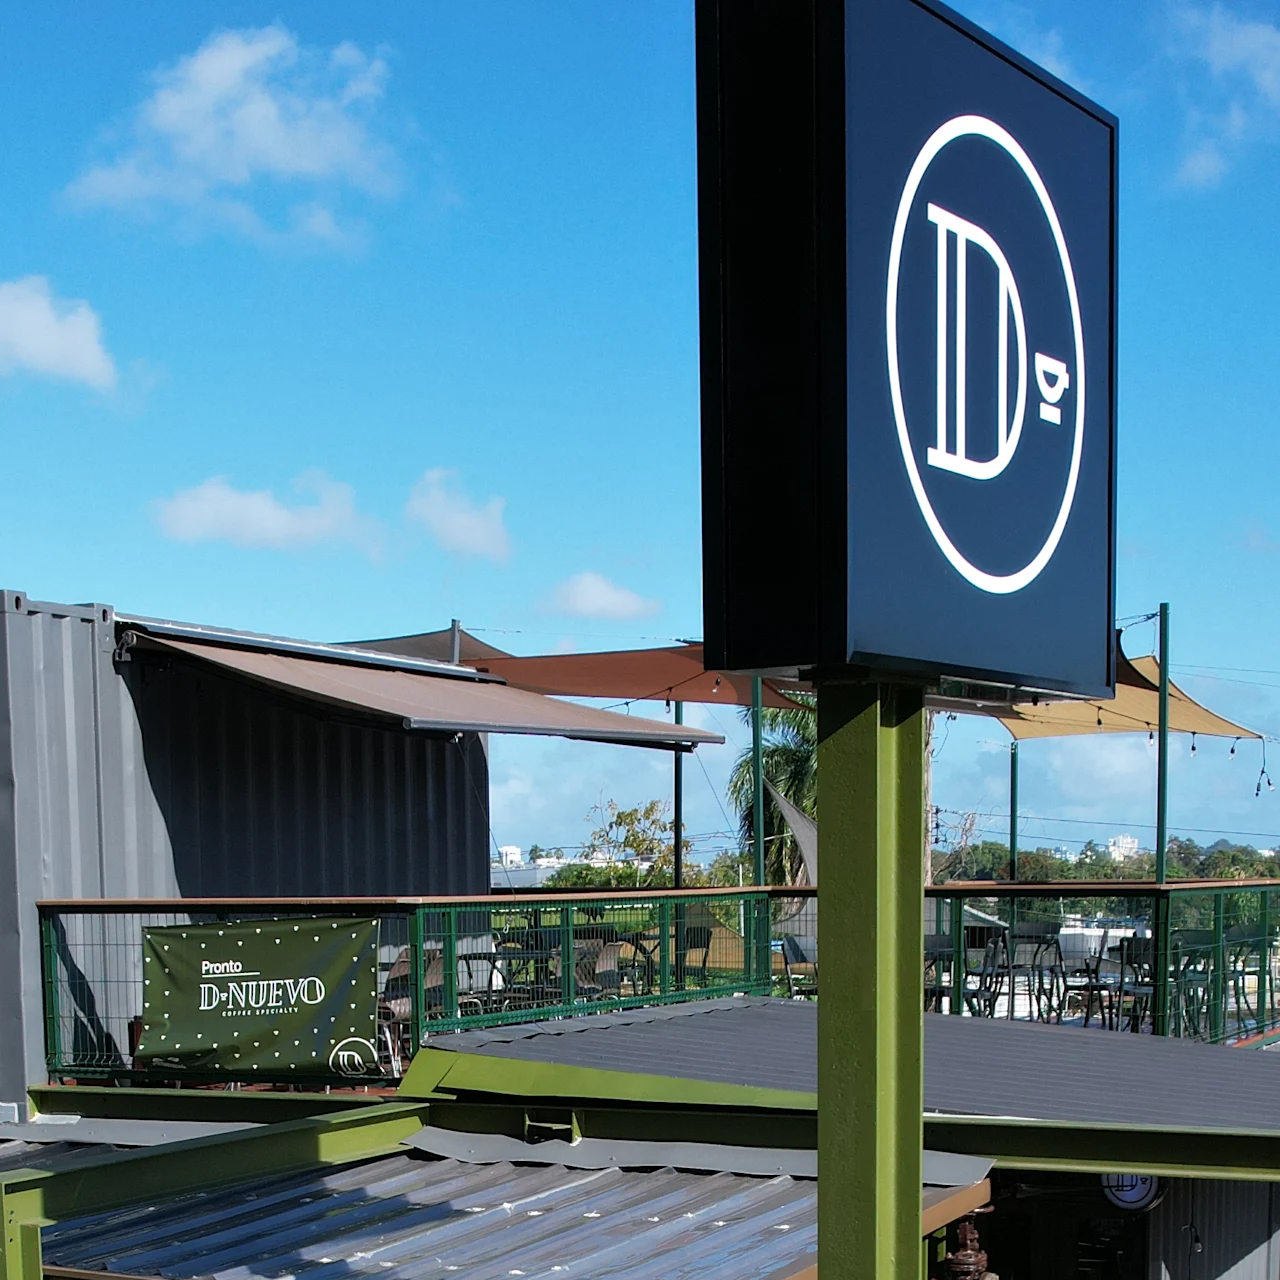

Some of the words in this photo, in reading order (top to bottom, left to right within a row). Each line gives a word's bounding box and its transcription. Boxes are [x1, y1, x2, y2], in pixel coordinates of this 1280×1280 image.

[201, 960, 243, 974] Pronto
[222, 1009, 252, 1017] COFFEE
[256, 1006, 299, 1016] SPECIALTY
